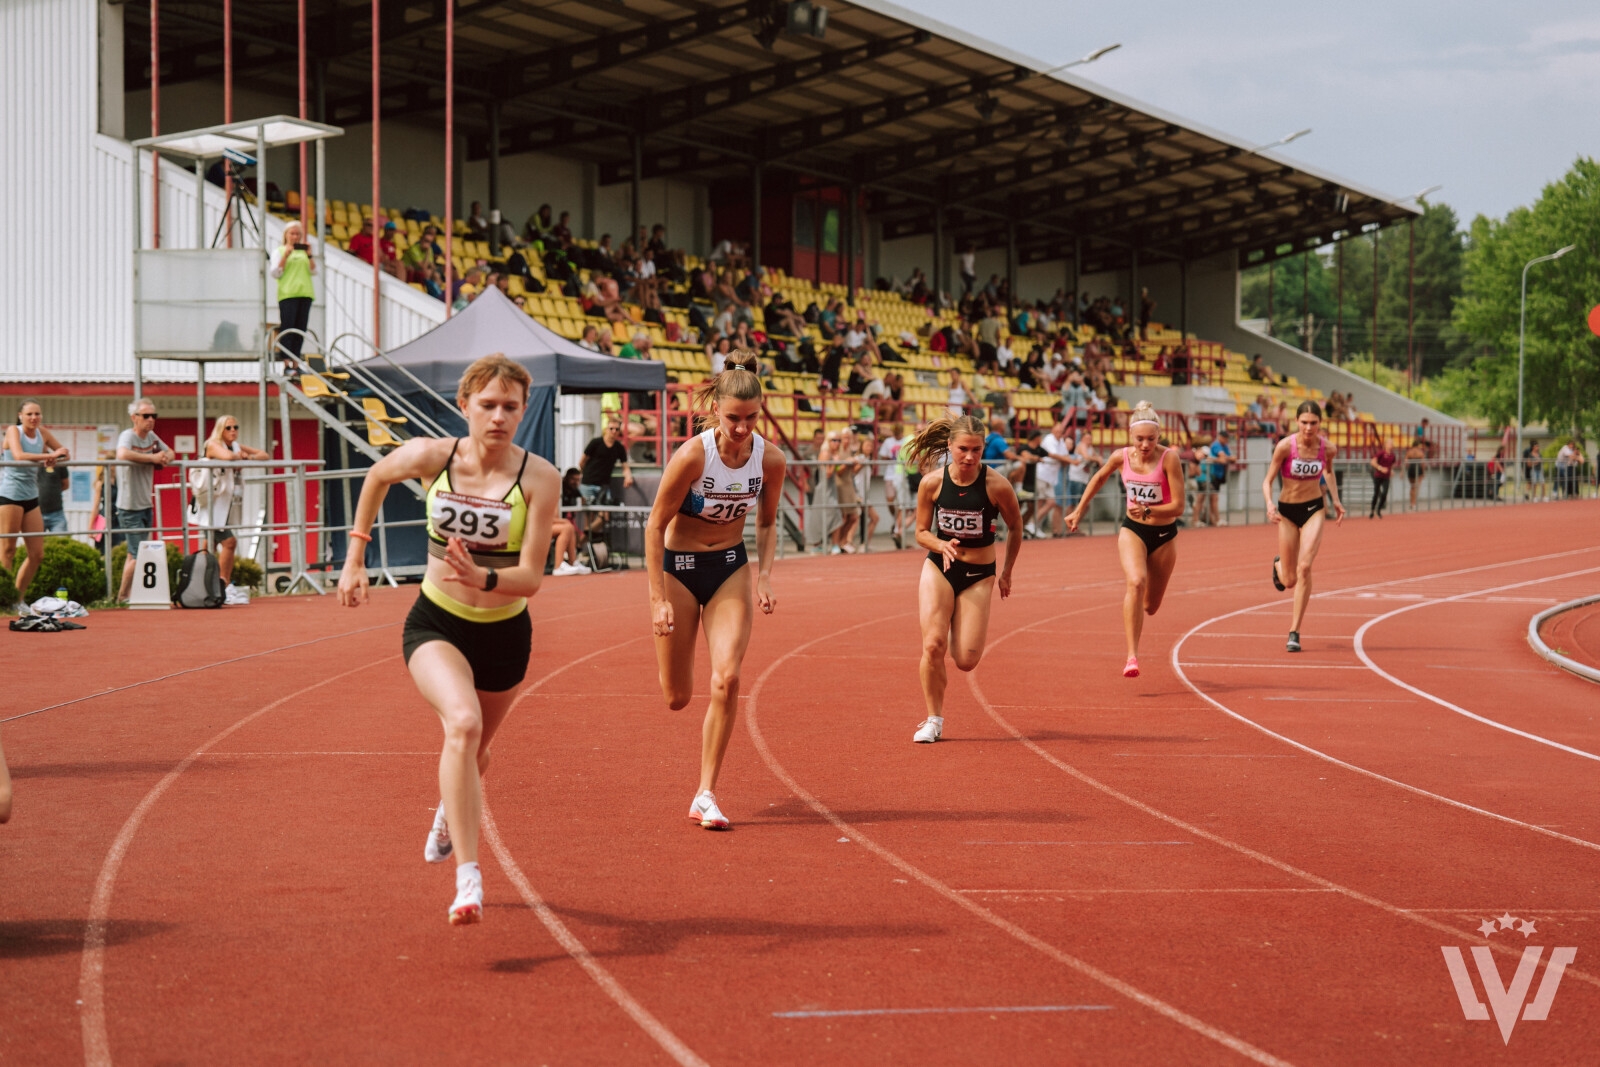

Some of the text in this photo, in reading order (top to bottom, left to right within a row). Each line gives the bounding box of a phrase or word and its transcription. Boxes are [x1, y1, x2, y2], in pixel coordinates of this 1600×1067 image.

[1294, 463, 1319, 474] 300
[1131, 487, 1157, 500] 144
[708, 502, 748, 519] 216
[439, 506, 500, 539] 293
[942, 516, 978, 531] 305
[143, 562, 157, 589] 8
